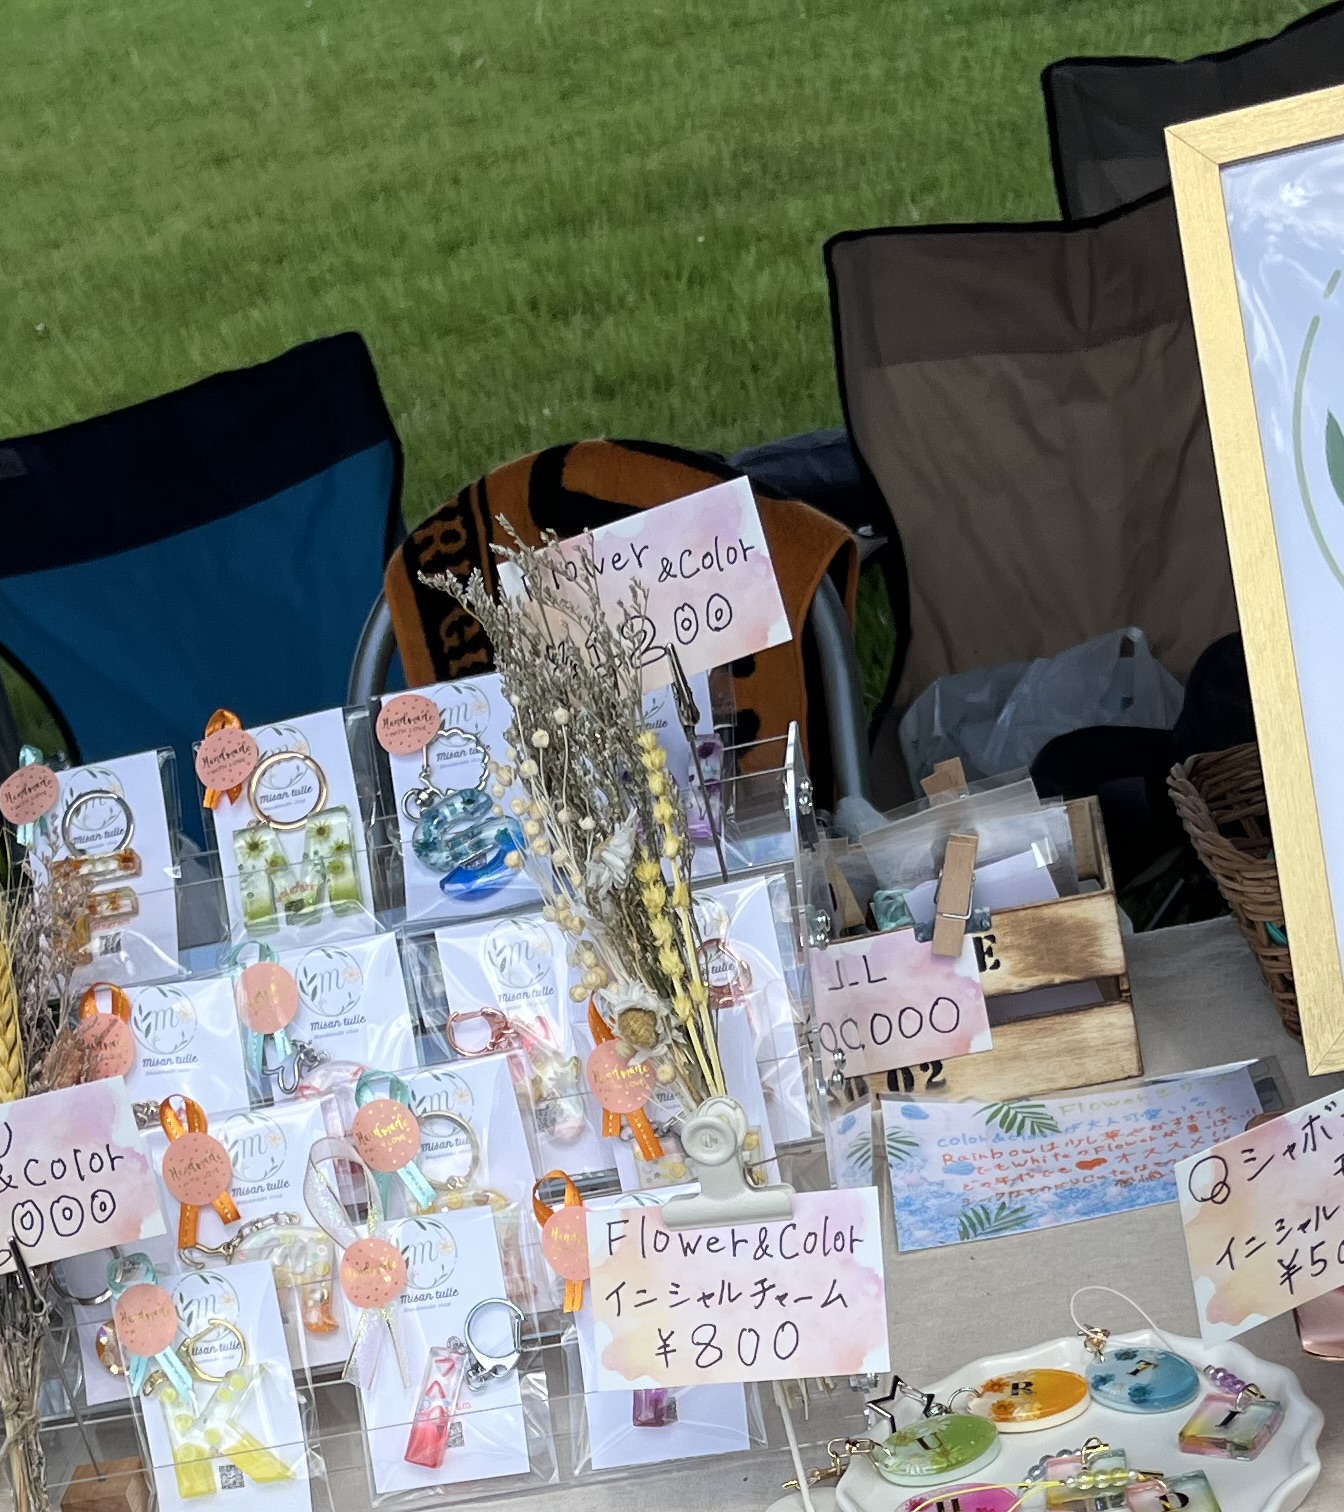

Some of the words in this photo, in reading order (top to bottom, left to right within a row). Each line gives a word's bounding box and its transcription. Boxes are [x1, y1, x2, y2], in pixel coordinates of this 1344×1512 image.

[605, 1278, 849, 1318] イニシャルチャーム
